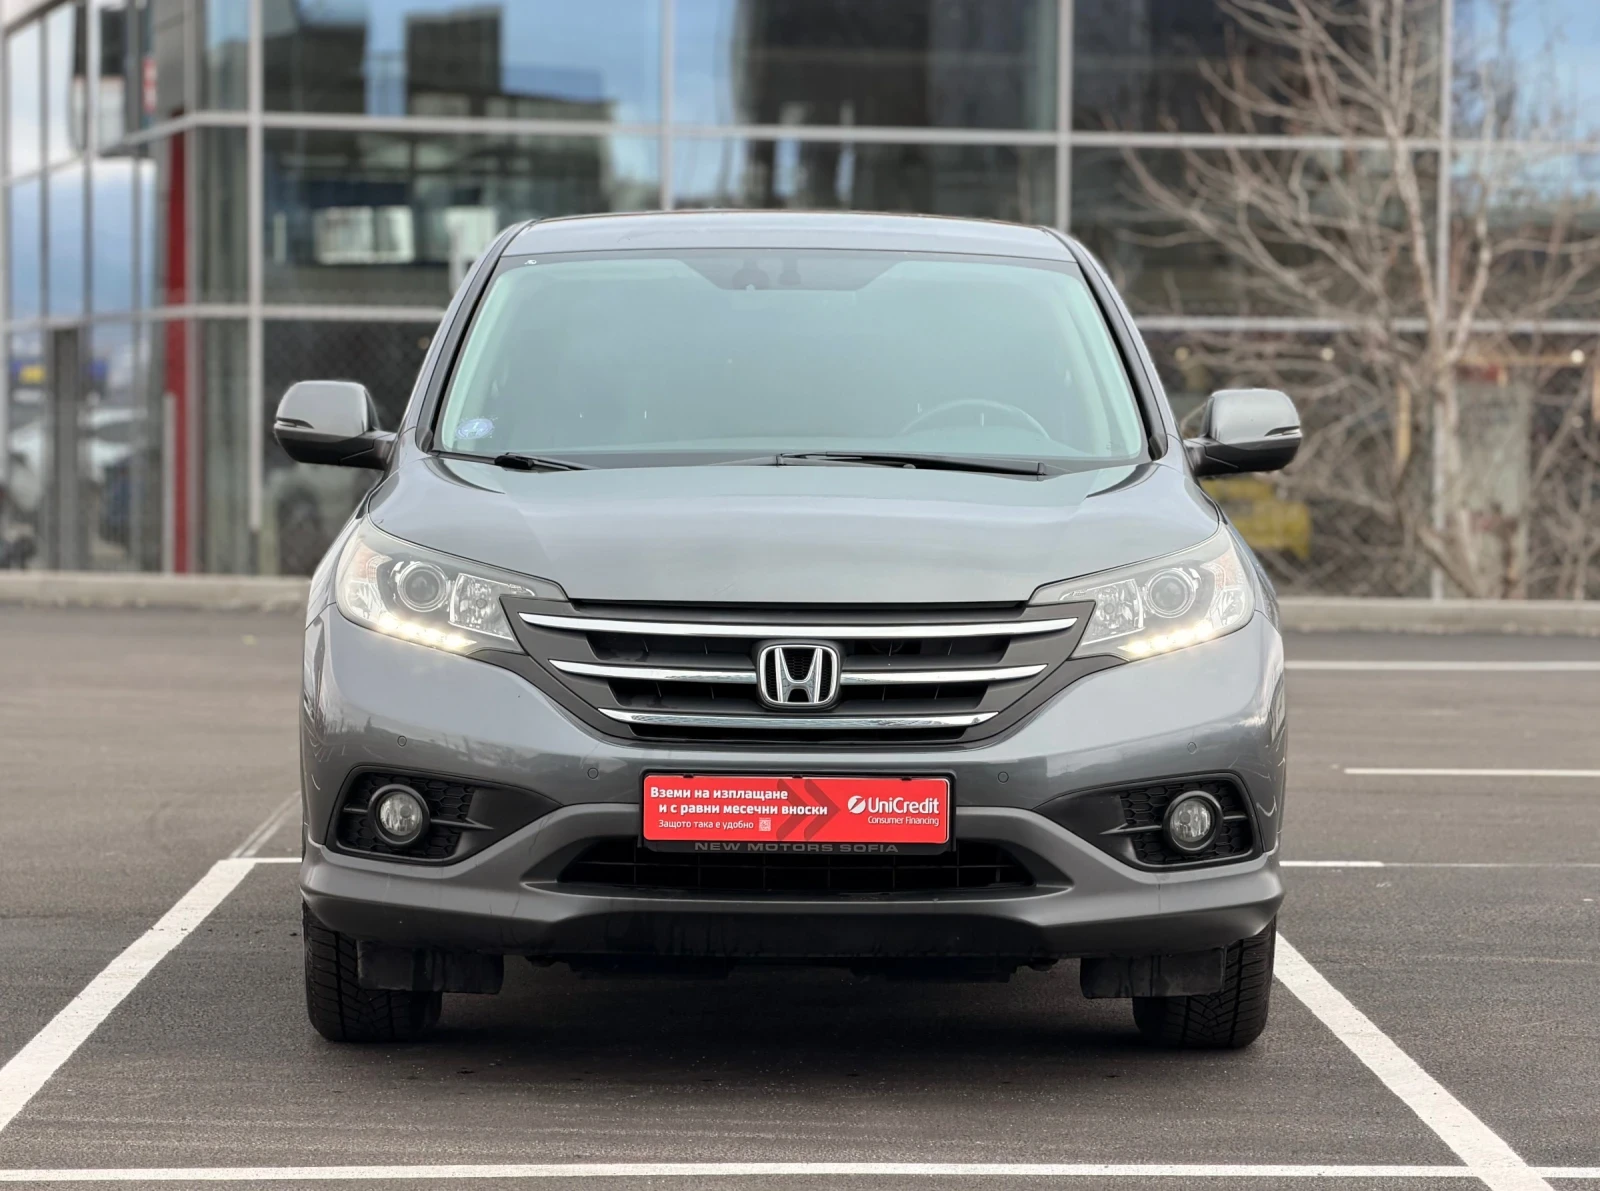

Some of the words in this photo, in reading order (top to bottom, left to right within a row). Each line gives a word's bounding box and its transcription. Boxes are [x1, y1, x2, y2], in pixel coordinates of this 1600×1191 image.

[650, 786, 691, 798] Вземи
[694, 789, 710, 799] на
[713, 789, 788, 801] изплащане
[659, 804, 667, 813] и
[670, 804, 677, 813] с
[680, 804, 720, 815] равни
[723, 805, 778, 815] месечни
[781, 805, 828, 815] вноски
[868, 797, 940, 814] UniCredit
[658, 819, 692, 829] Защото
[693, 821, 714, 829] така
[715, 821, 721, 829] е
[722, 822, 754, 830] удобно
[867, 815, 904, 825] Consumer
[905, 816, 940, 827] Financing
[694, 842, 741, 851] NEW
[747, 843, 833, 852] MOTORS
[839, 844, 899, 853] SOFIA
